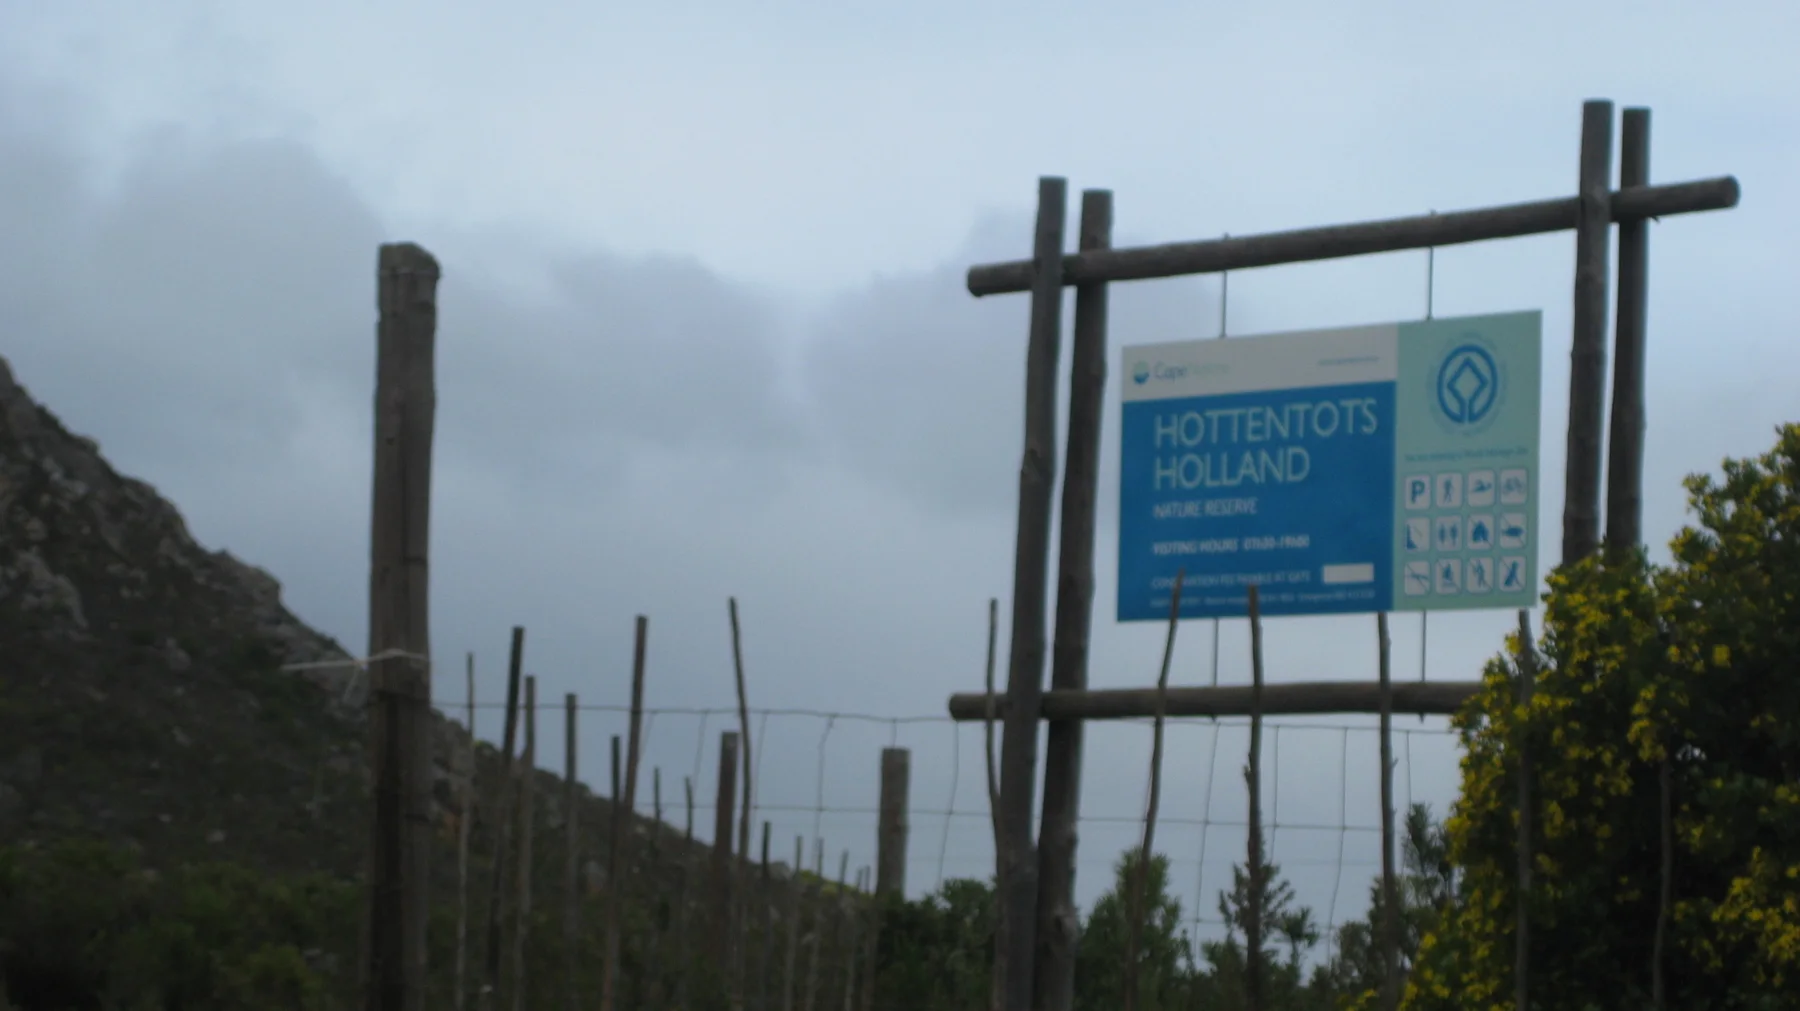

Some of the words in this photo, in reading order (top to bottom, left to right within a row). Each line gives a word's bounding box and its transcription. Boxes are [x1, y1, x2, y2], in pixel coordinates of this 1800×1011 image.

[1155, 397, 1377, 448] HOTTENTOTS
[1154, 446, 1310, 490] HOLLAND
[1153, 502, 1202, 519] NATURE
[1204, 497, 1258, 517] RESERVE
